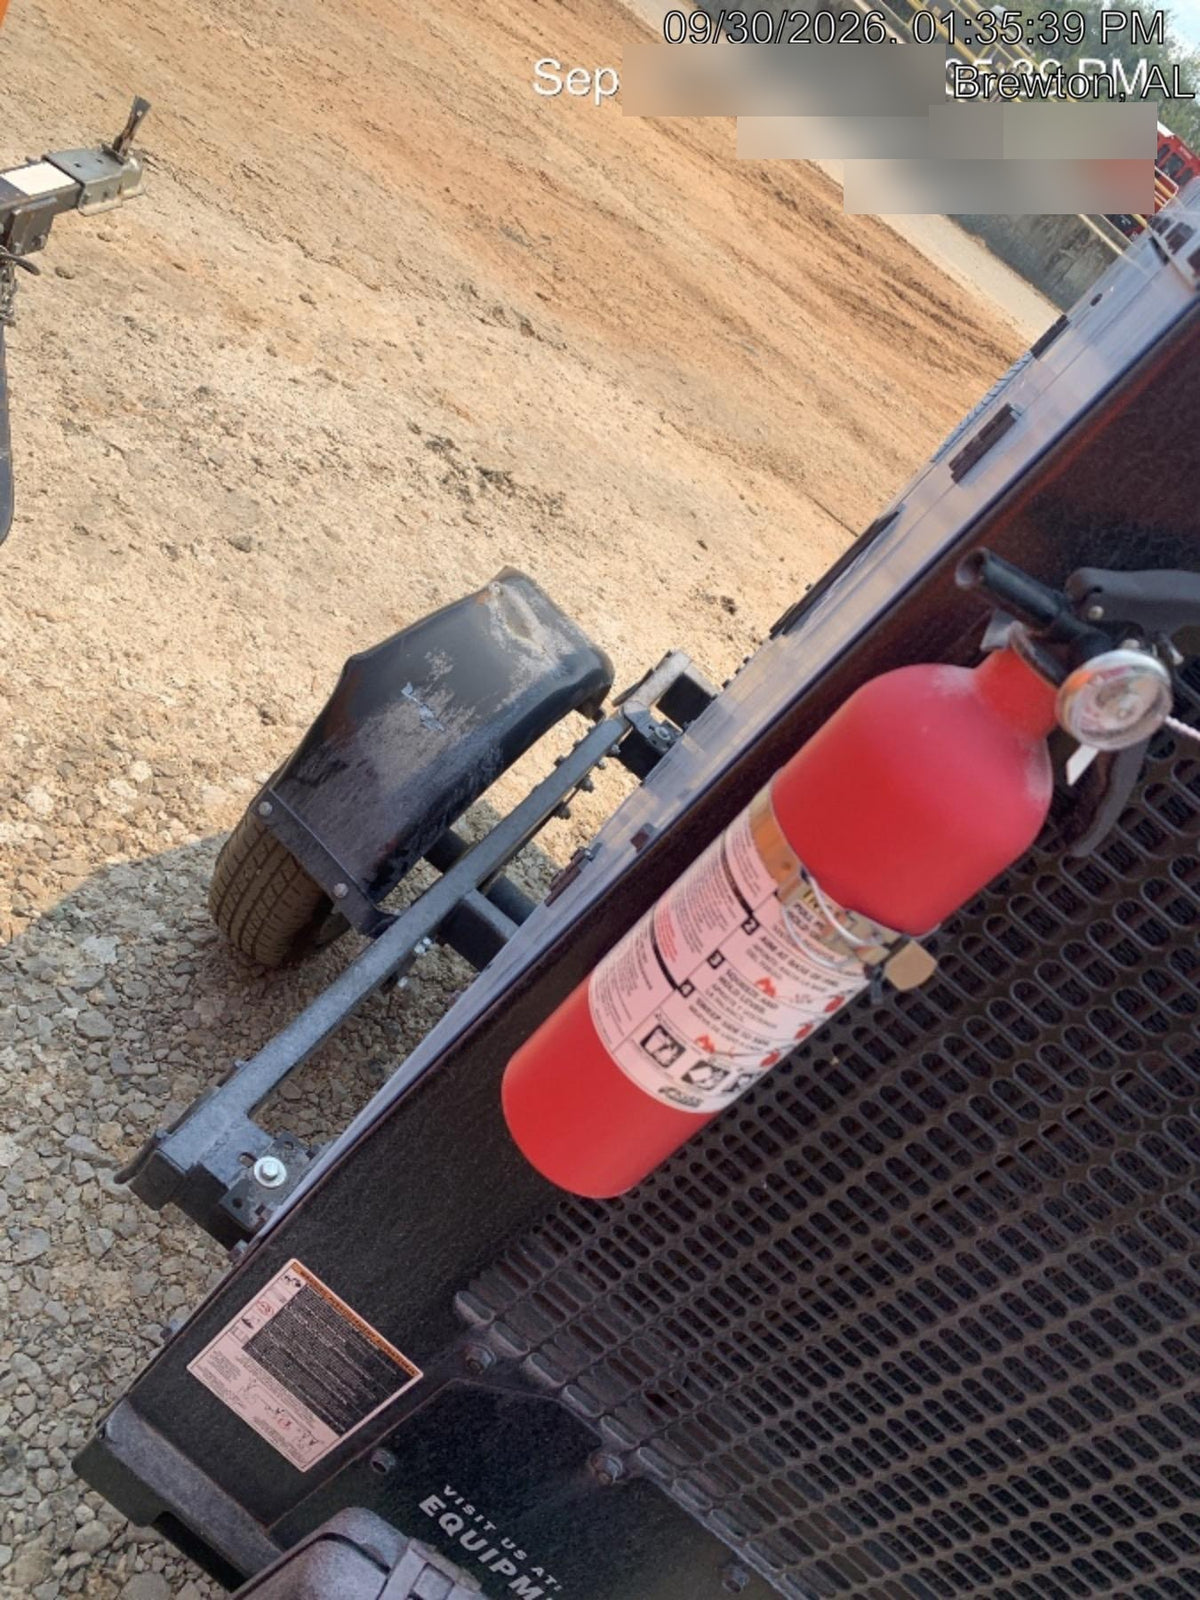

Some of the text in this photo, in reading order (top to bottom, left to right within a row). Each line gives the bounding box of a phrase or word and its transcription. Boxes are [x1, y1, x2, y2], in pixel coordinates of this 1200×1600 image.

[418, 1494, 556, 1600] EQUIPM
[443, 1484, 497, 1531] VISIT
[500, 1537, 527, 1560] US
